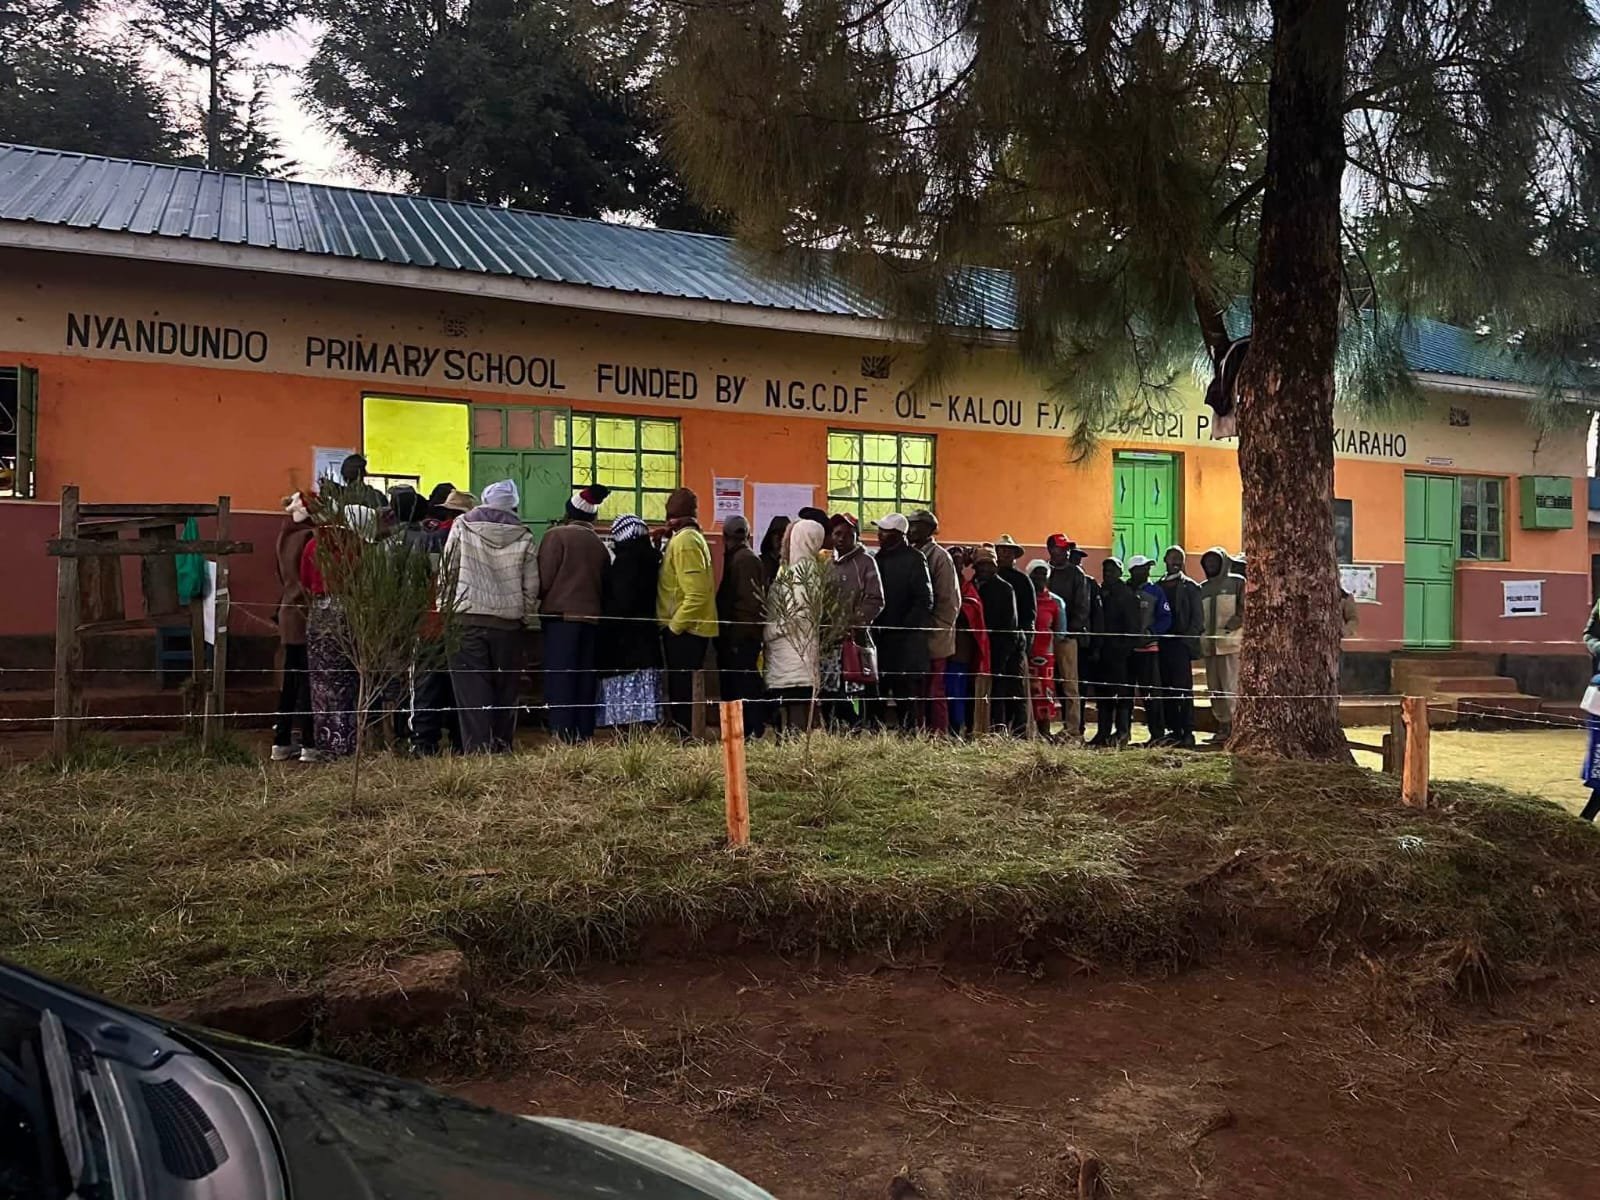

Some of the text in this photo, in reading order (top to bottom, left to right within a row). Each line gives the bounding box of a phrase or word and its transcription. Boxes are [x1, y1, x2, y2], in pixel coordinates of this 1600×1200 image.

[67, 312, 268, 363] NYANDUNDO
[306, 336, 441, 377] PRIMARY
[443, 350, 566, 389] SCHOOL
[597, 363, 698, 400] FUNDED
[716, 374, 747, 404] BY
